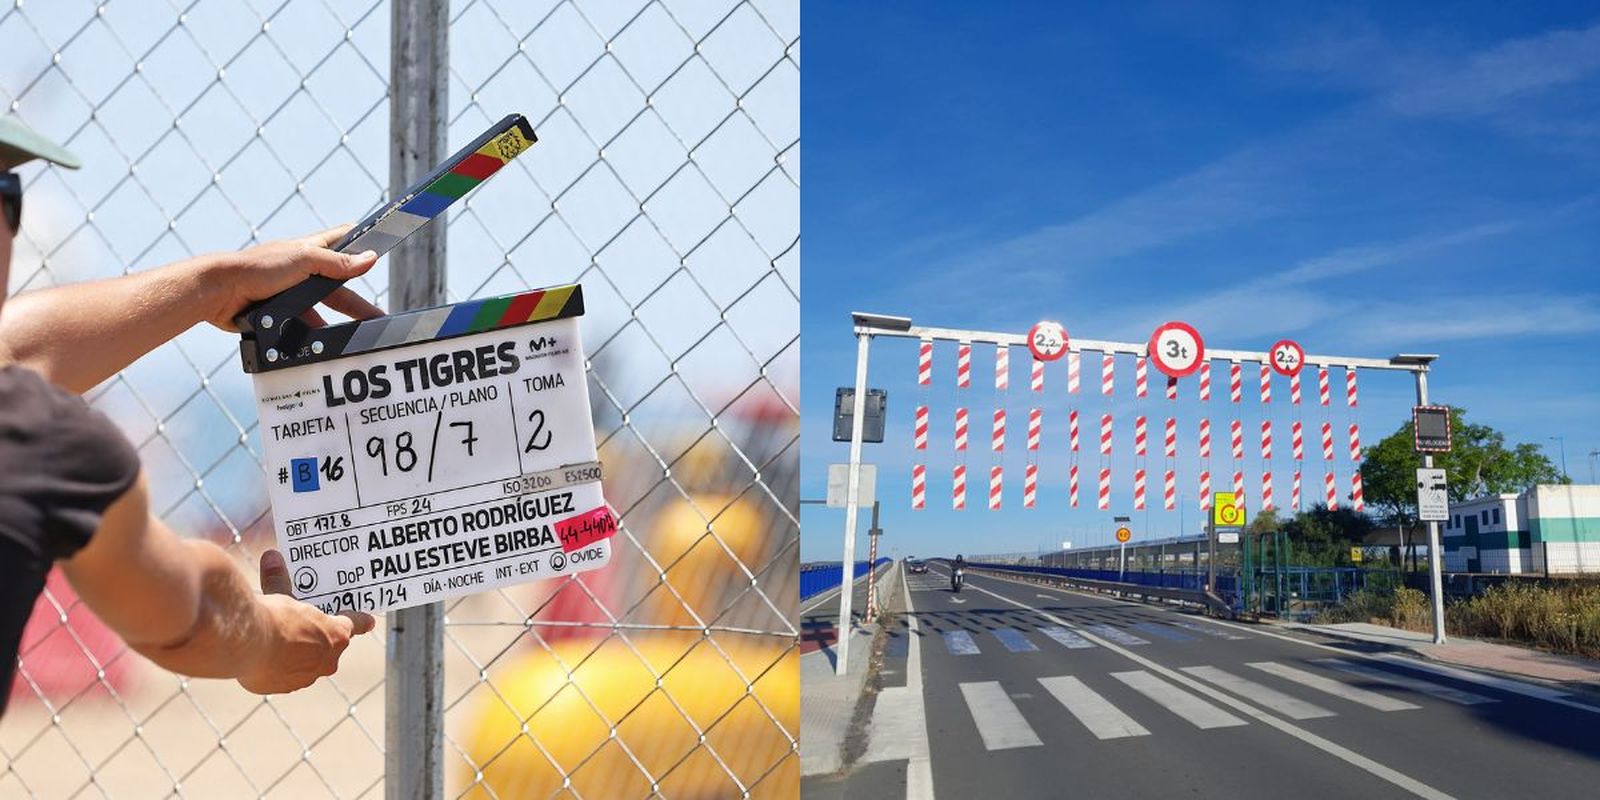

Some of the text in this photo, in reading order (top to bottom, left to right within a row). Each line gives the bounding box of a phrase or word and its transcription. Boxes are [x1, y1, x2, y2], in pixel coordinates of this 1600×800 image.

[323, 341, 520, 408] LOS TIGRES
[523, 373, 565, 393] TOMA
[360, 397, 438, 425] SECUENCIA
[450, 384, 498, 408] PLANO
[271, 415, 335, 441] TARJETA
[524, 409, 552, 453] 2
[320, 455, 344, 481] 16
[503, 480, 521, 495] ISO
[523, 475, 552, 490] 3200
[386, 497, 431, 517] FPS 24
[286, 520, 309, 537] OBT
[290, 535, 360, 562] DIRECTOR
[367, 513, 458, 552] ALBERTO
[462, 491, 575, 533] RODRÍGUEZ
[336, 524, 555, 586] DoP PAU ESTEVE BIRBA
[570, 547, 603, 563] OVIDE
